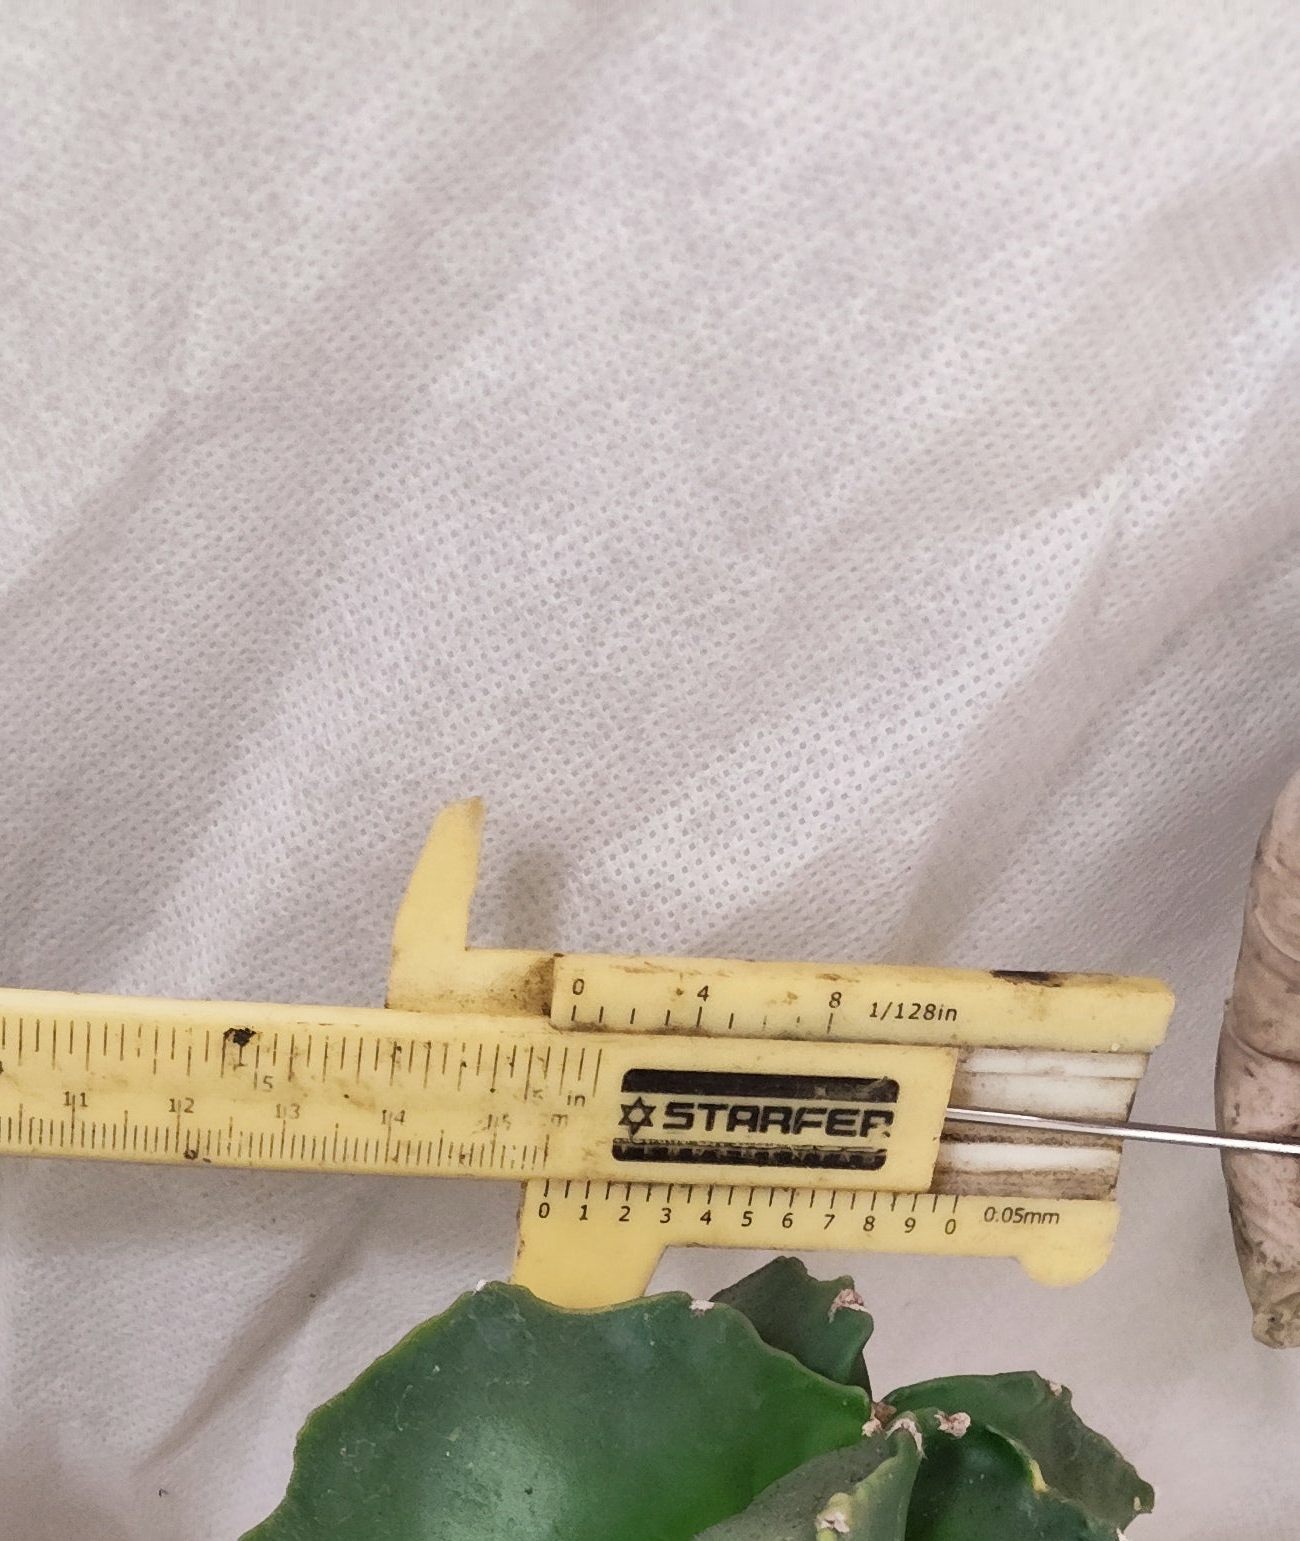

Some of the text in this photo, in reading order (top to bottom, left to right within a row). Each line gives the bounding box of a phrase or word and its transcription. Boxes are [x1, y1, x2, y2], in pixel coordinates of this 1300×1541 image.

[572, 978, 958, 1022] 0 4 8 1/128in
[64, 1092, 88, 1107] 11
[168, 1099, 194, 1114] 12
[276, 1104, 300, 1119] 13
[382, 1109, 406, 1124] 14
[263, 1076, 273, 1090] 5
[567, 1093, 585, 1107] in
[663, 1102, 894, 1137] STARFER
[538, 1202, 1060, 1235] 0 1 2 3 4 5 6 7 8 9 0 0.05mm
